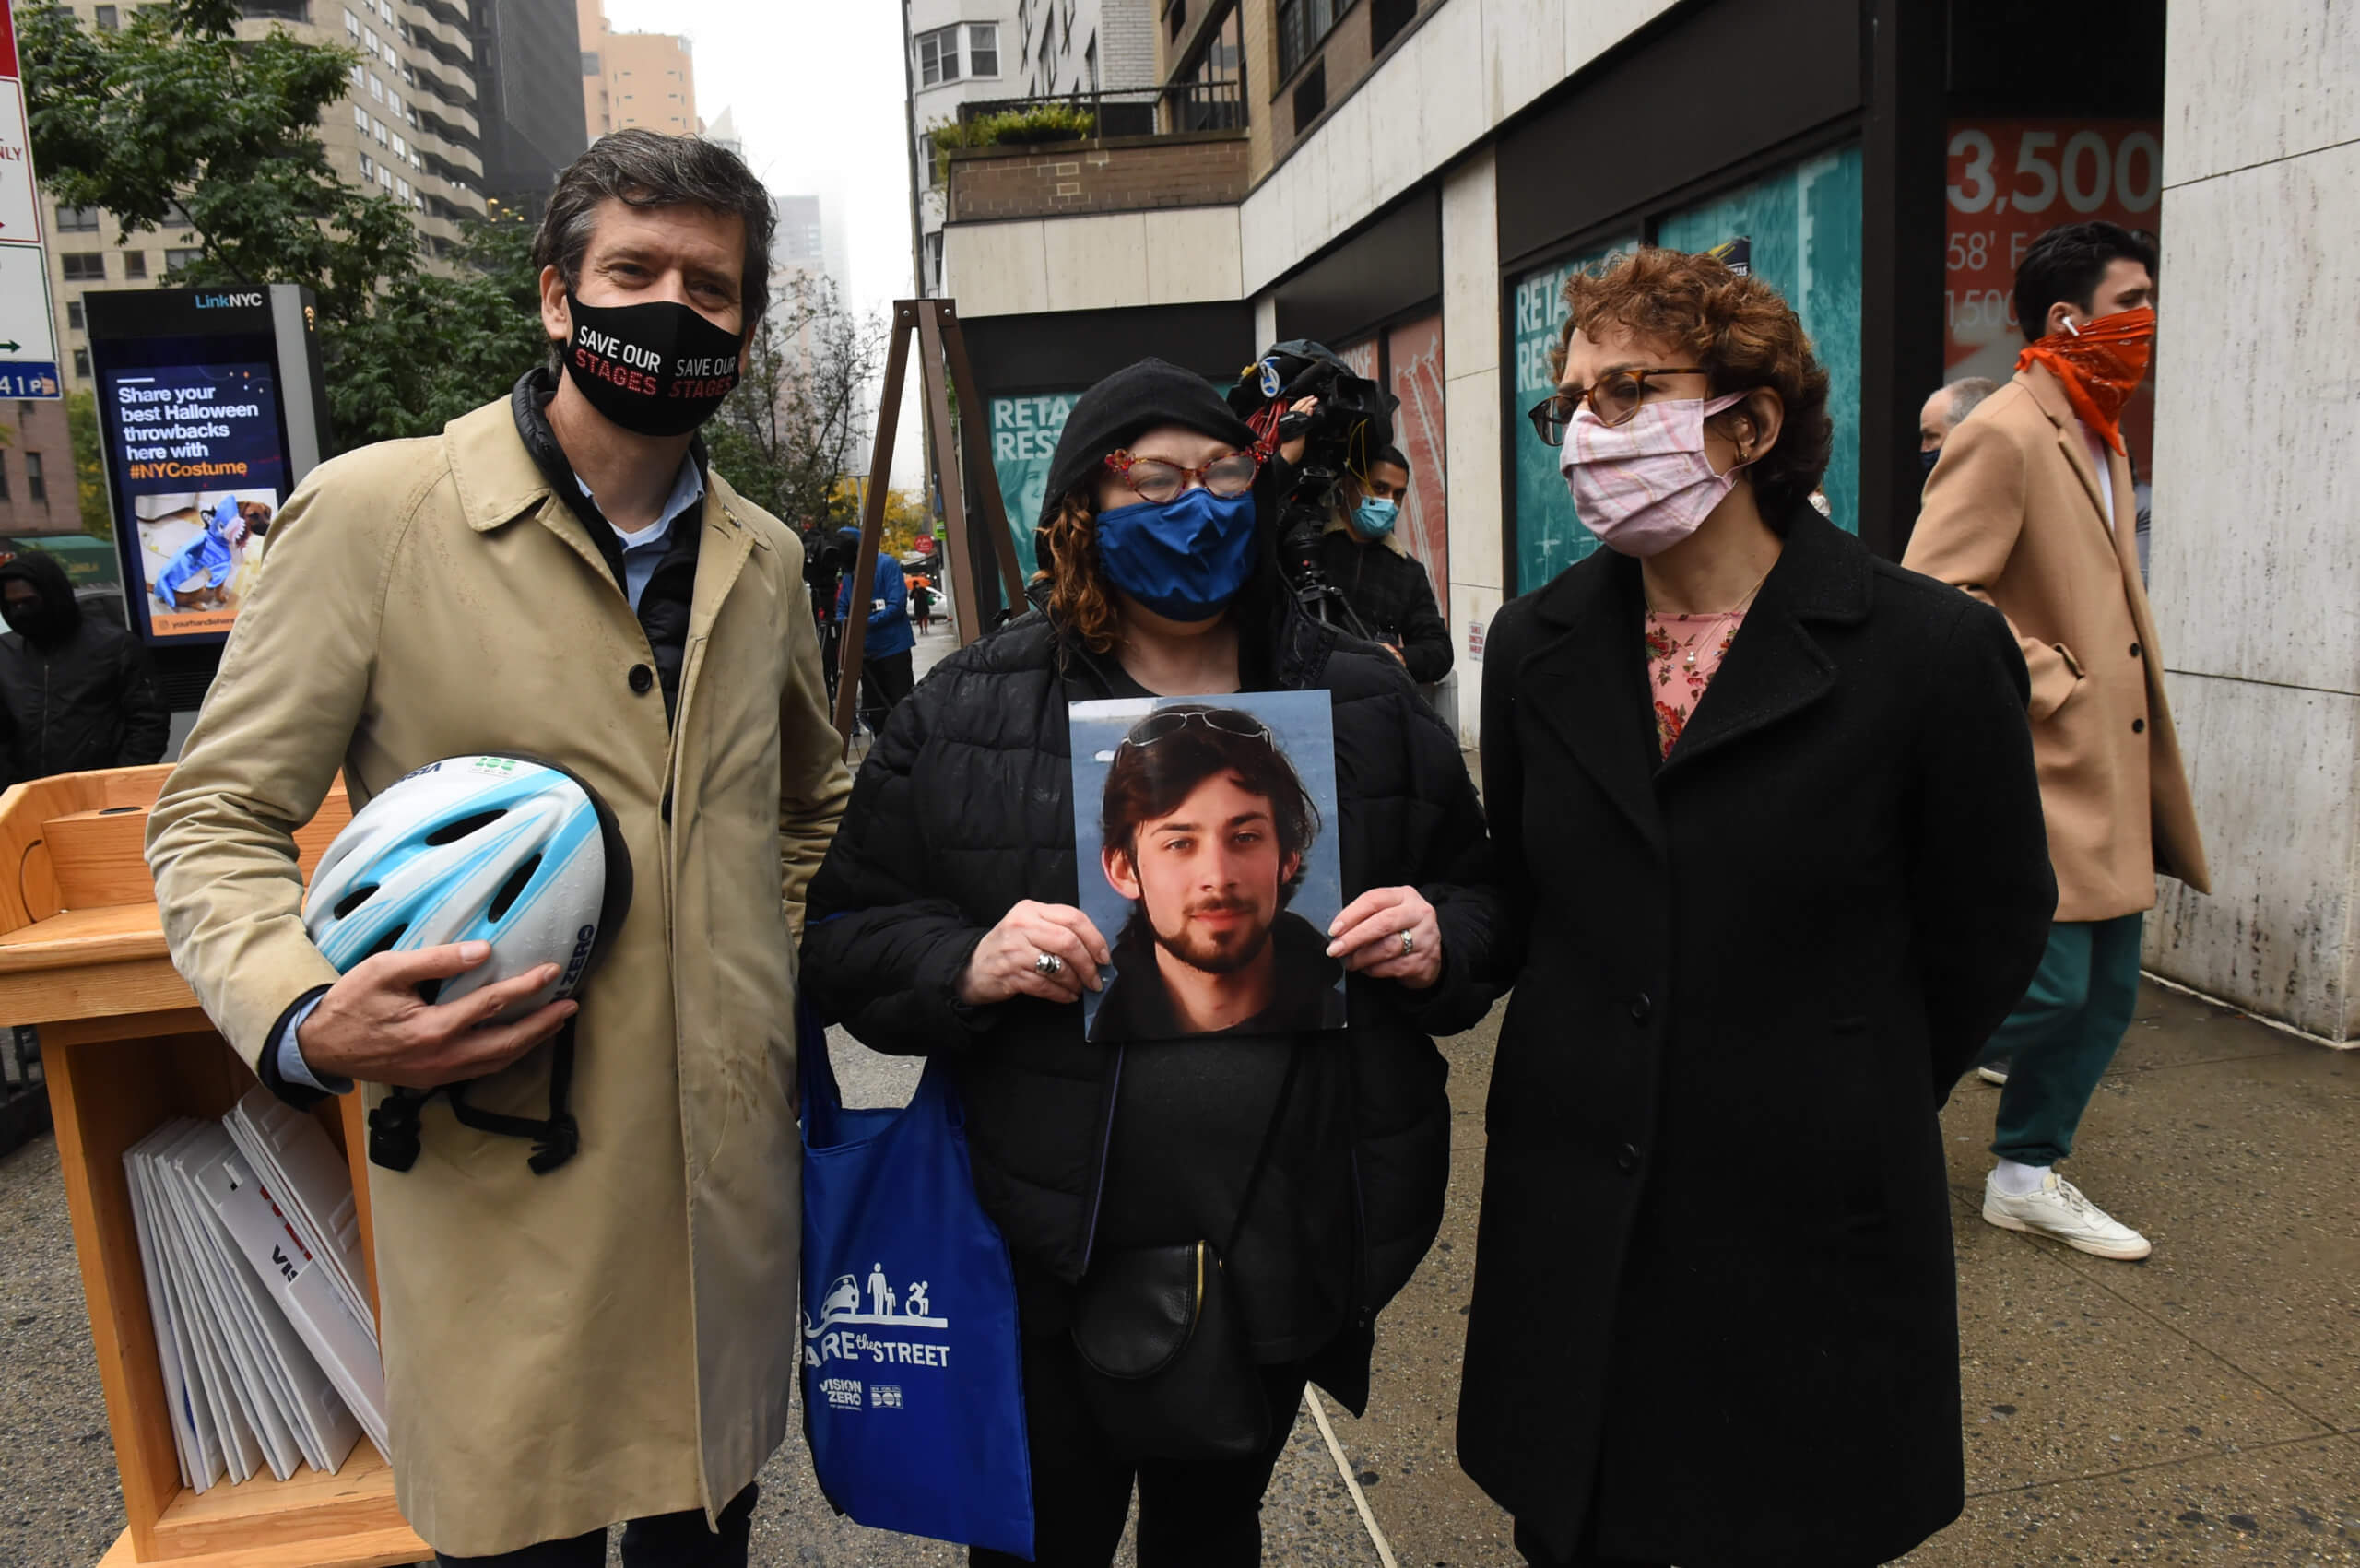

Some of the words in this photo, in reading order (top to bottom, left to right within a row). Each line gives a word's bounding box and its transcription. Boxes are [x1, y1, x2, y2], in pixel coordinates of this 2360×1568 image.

[1946, 233, 1995, 270] 58'
[195, 292, 263, 309] LinkNYC
[578, 325, 621, 359] SAVE
[622, 344, 662, 373] OUR
[575, 348, 657, 396] STAGES
[675, 358, 713, 378] SAVE
[714, 356, 737, 376] OUR
[118, 387, 171, 404] Share
[173, 386, 216, 404] your
[668, 375, 734, 399] STAGES
[121, 407, 161, 422] best
[164, 404, 259, 421] Halloween
[994, 396, 1082, 429] RETA
[124, 422, 230, 442] throwbacks
[126, 445, 167, 461] here
[170, 442, 210, 458] with
[996, 430, 1063, 461] RES
[129, 462, 248, 479] #NYCostume
[560, 924, 595, 986] ZERO
[855, 1333, 875, 1351] the
[872, 1340, 950, 1368] STREET
[819, 1378, 863, 1394] VISION
[827, 1390, 862, 1407] ZERO
